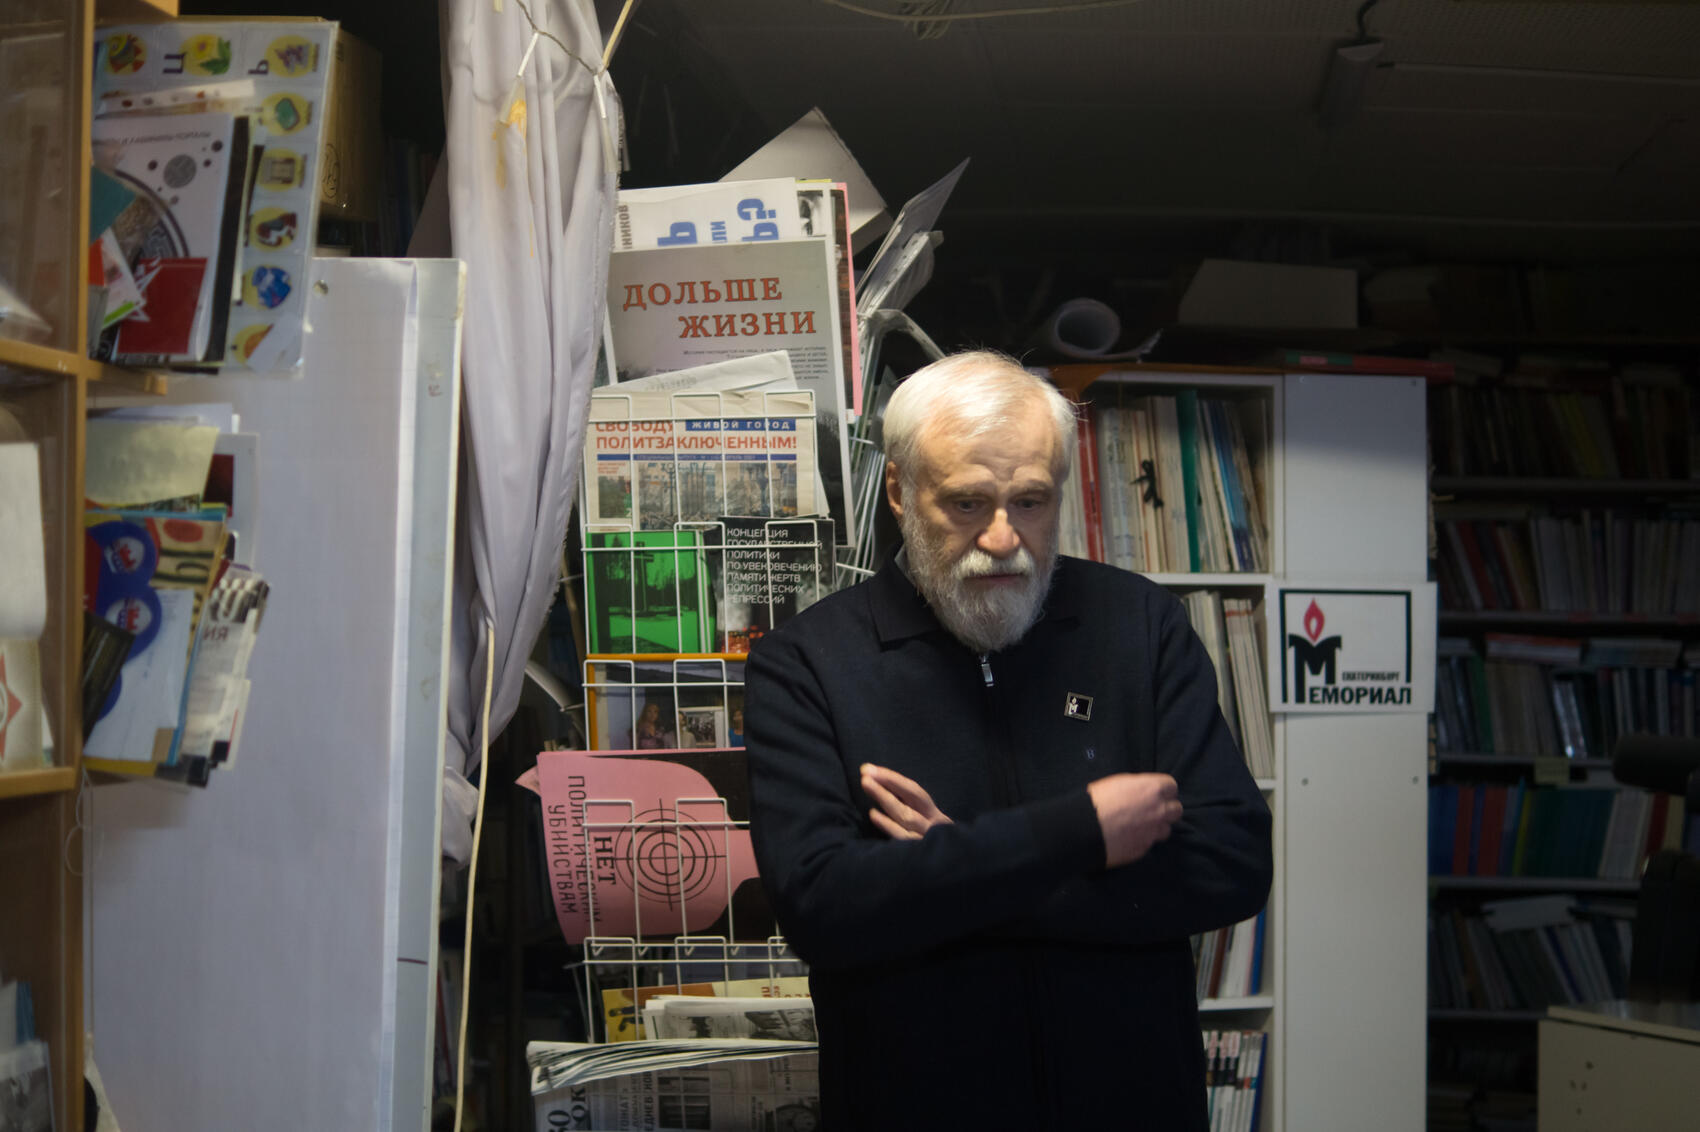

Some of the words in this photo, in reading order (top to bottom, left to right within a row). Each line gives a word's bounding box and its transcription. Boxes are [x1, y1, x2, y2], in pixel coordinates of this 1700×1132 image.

[623, 277, 783, 311] ДОЛЬШЕ
[679, 311, 816, 339] ЖИЗНИ
[747, 420, 790, 430] ГООД
[596, 436, 797, 449] ПОЛИТЗАКЛЮЧЕННЫМ!
[727, 561, 741, 570] ПО
[727, 572, 766, 582] ПАМЯТИ
[593, 836, 617, 885] НЕТ
